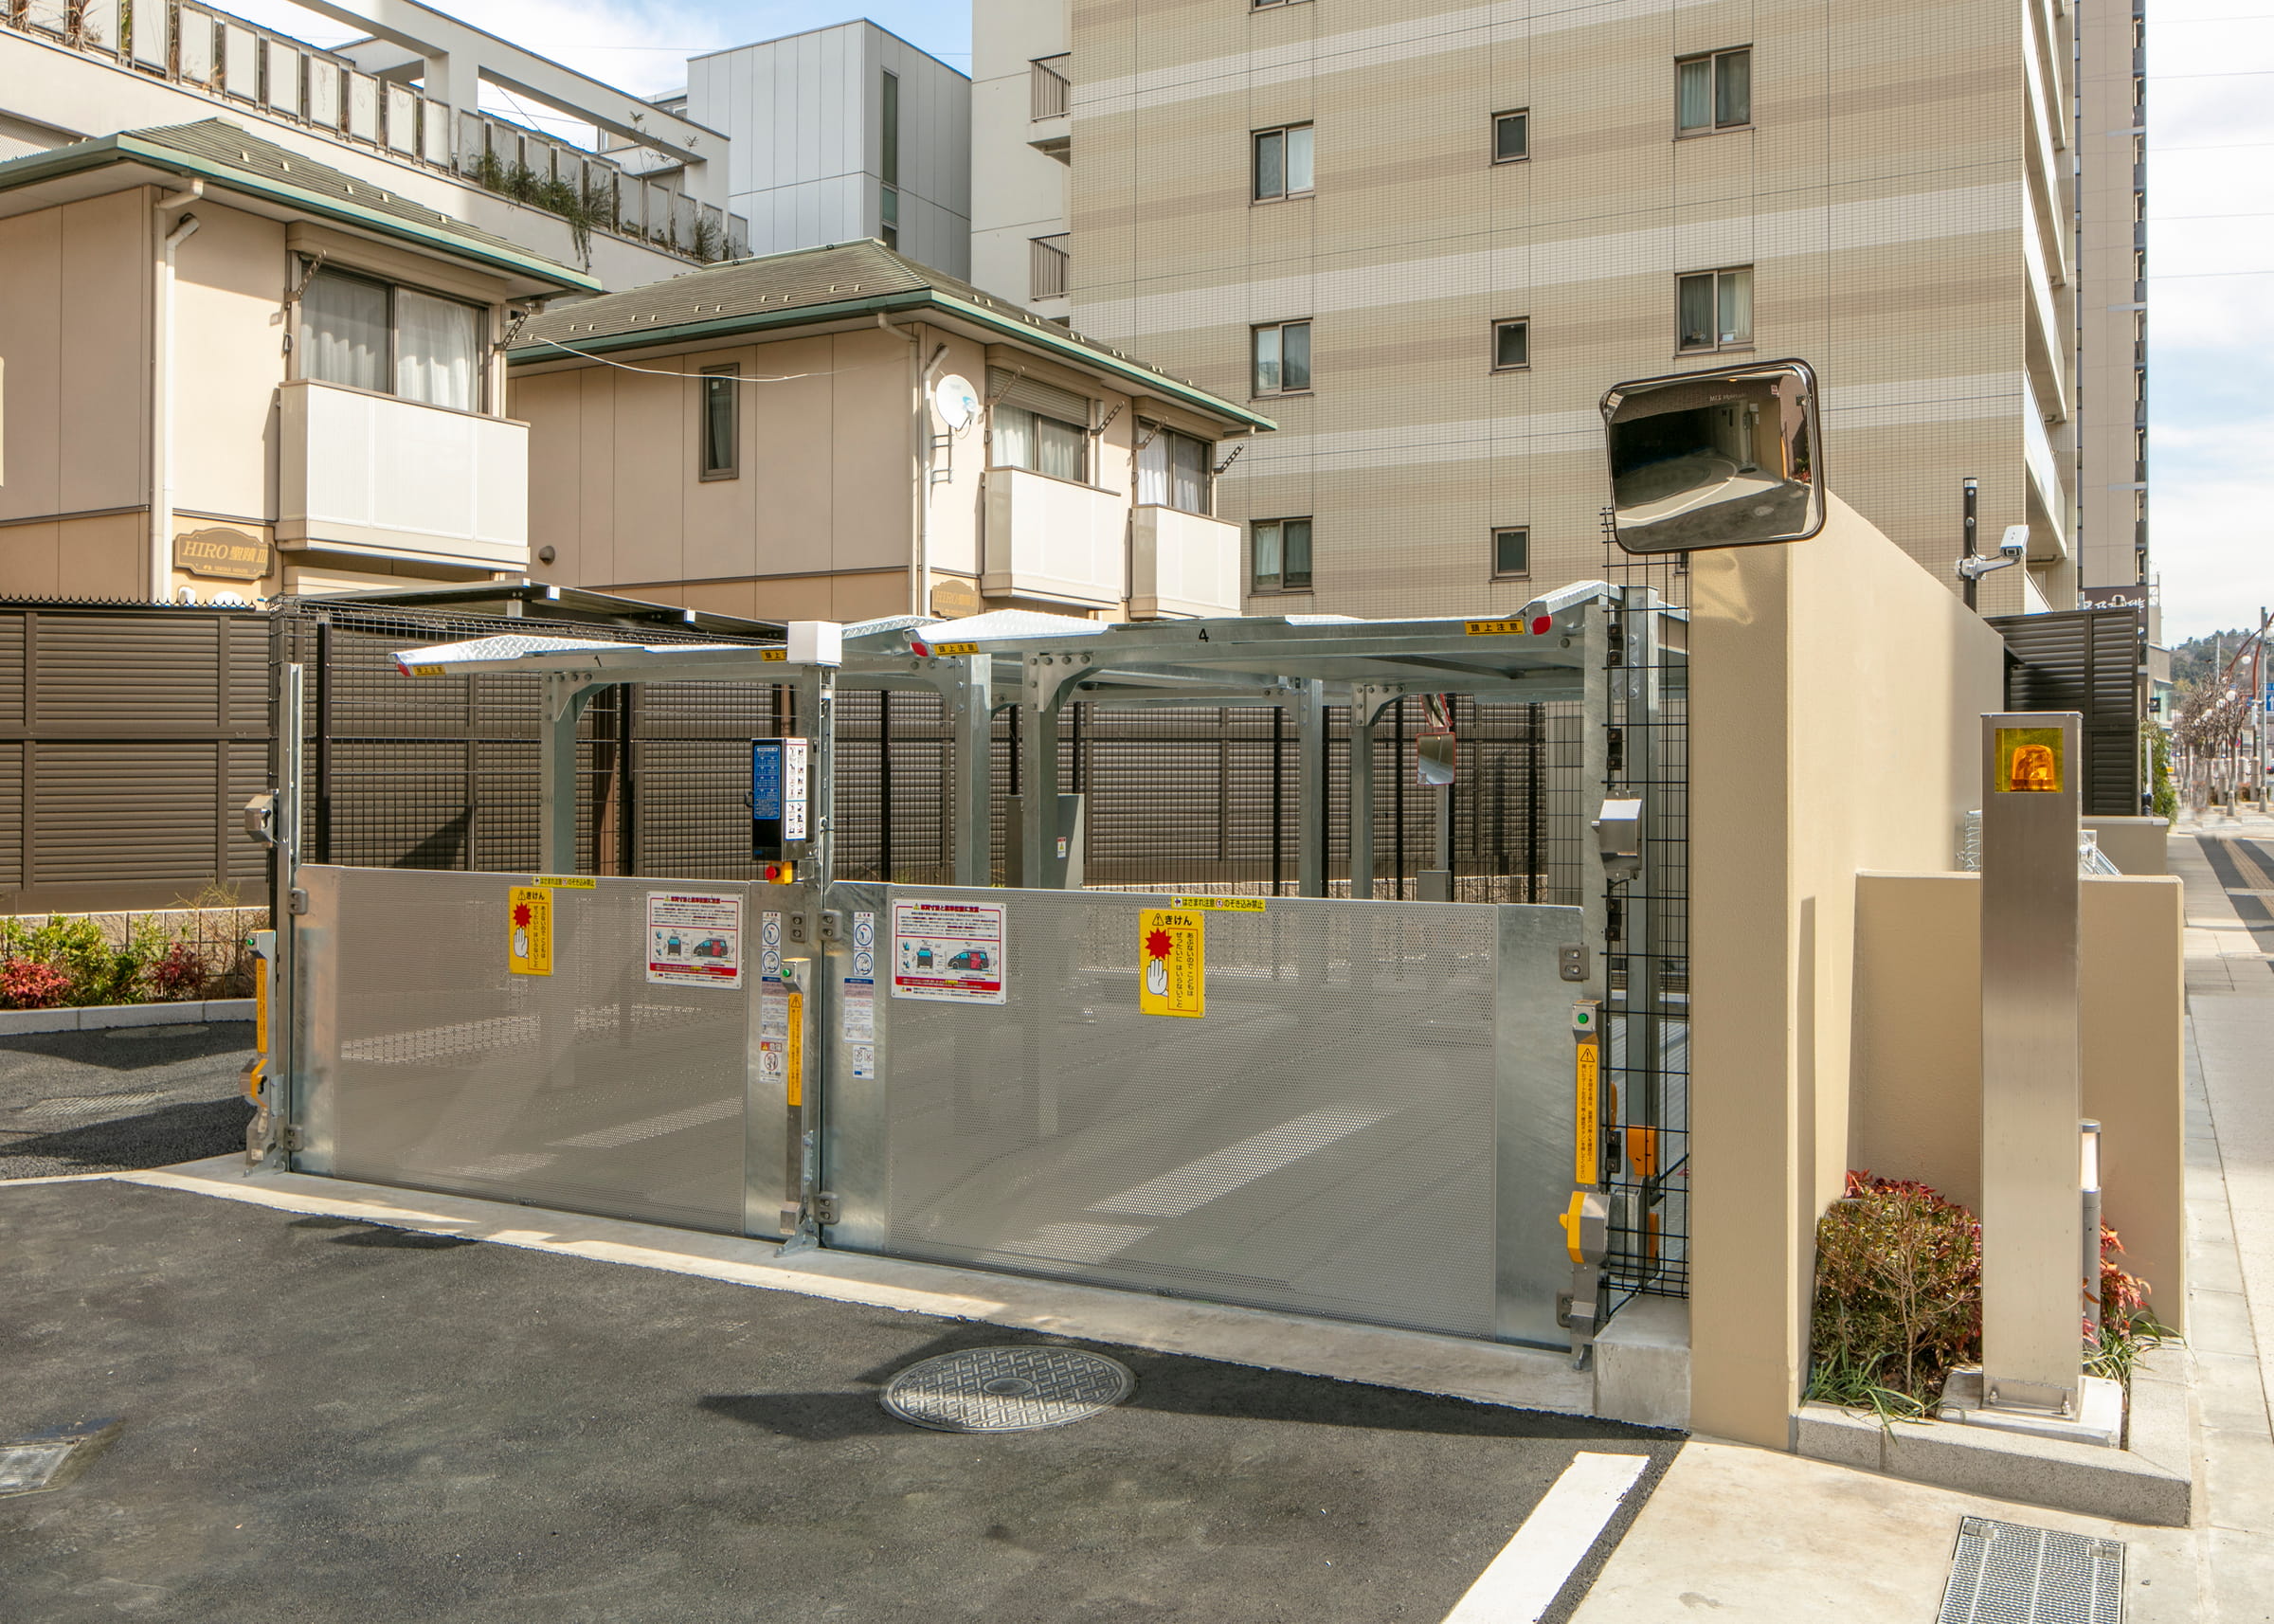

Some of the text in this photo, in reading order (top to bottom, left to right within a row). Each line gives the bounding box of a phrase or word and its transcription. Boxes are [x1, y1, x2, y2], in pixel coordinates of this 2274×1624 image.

[182, 541, 228, 559] HIRO
[1470, 622, 1520, 633] 頭上注意
[1198, 628, 1209, 643] 4
[526, 892, 546, 901] きけん
[1182, 899, 1263, 910] はさまれ注意 のぞき込み禁止
[1165, 915, 1192, 926] きけん
